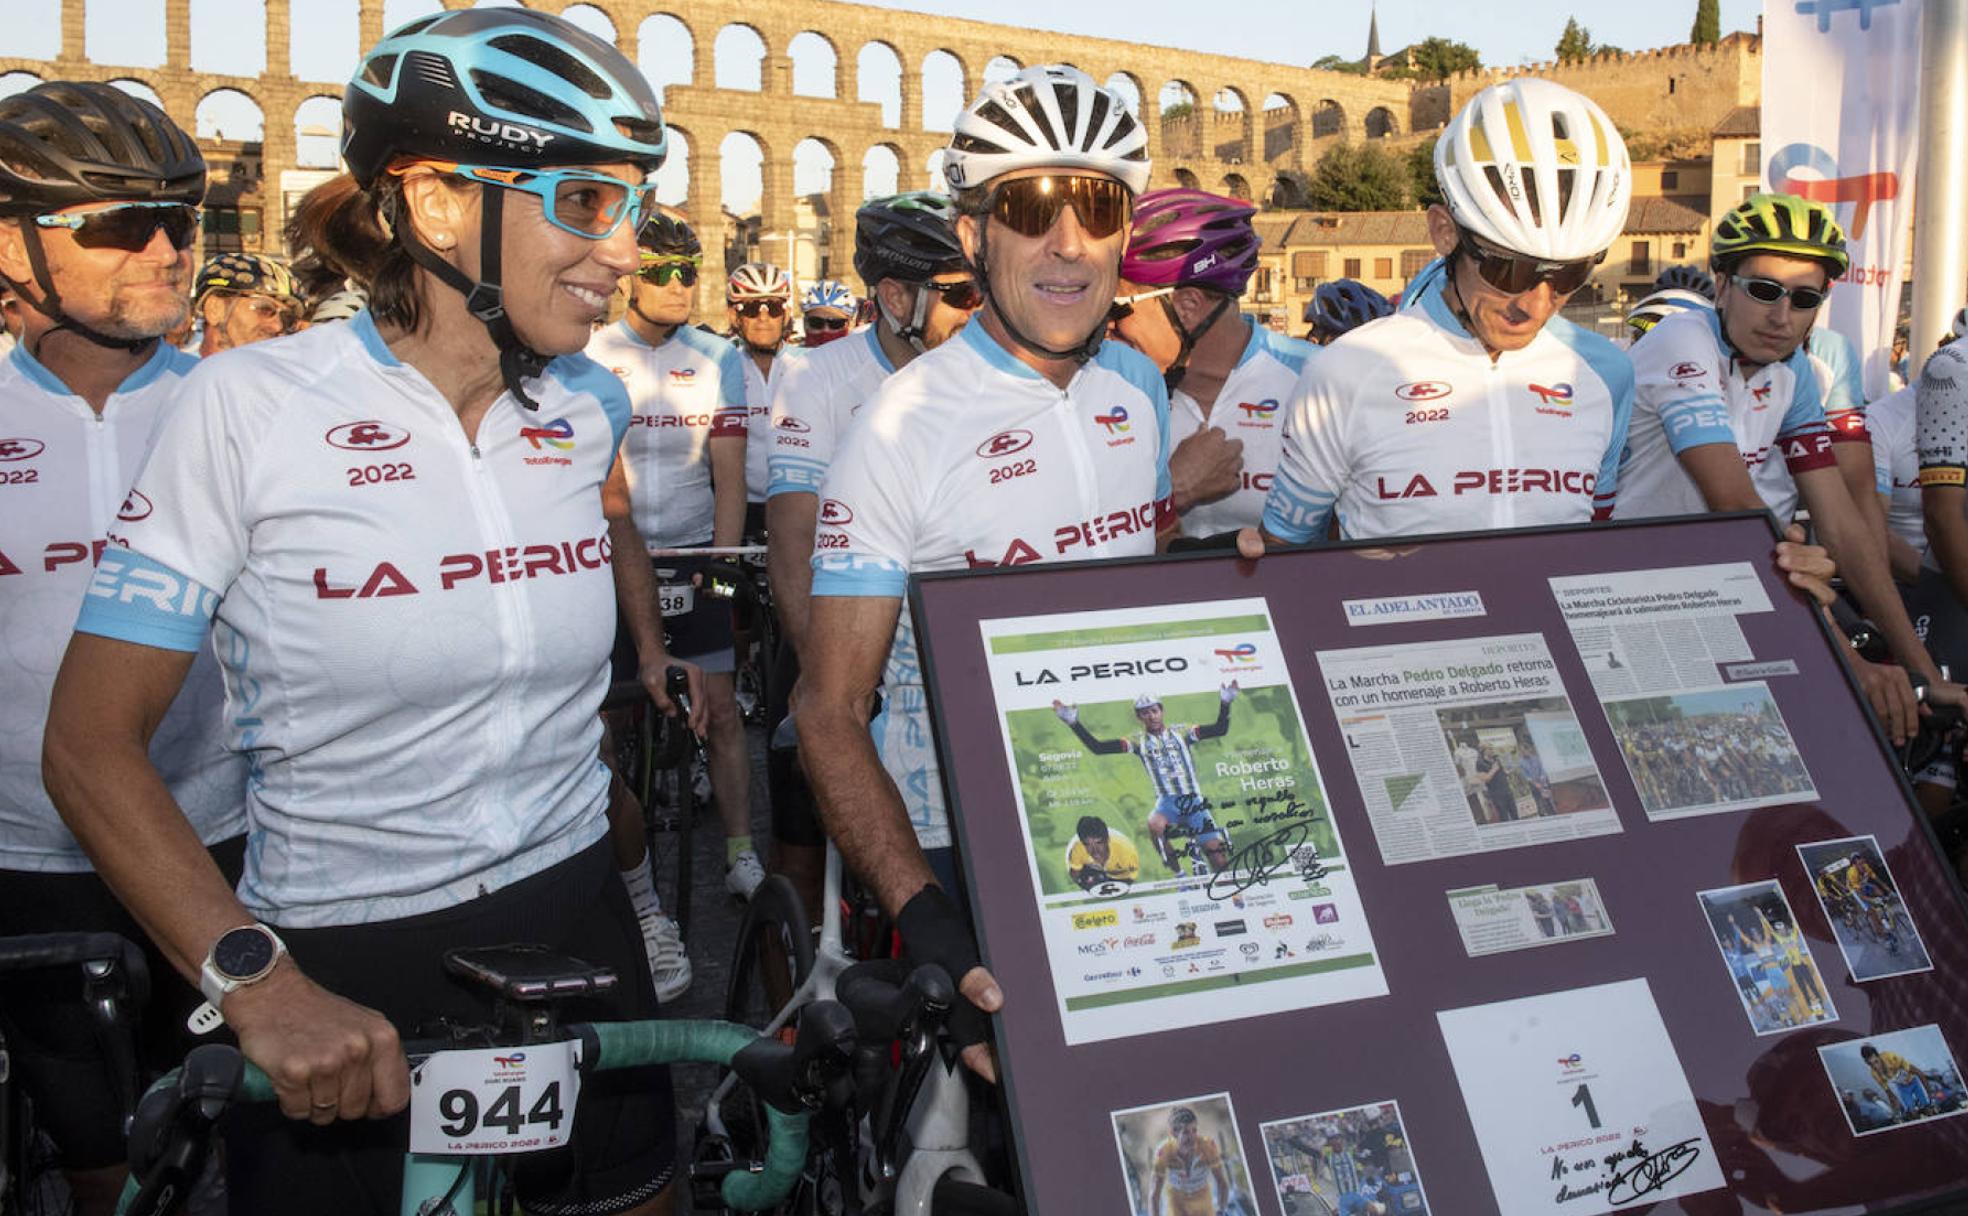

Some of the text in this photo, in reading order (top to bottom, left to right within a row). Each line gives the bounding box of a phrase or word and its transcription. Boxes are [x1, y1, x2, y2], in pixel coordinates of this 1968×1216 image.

[447, 110, 555, 148] RUDY
[454, 128, 544, 155] PROJECT
[629, 413, 711, 428] PERICO
[1405, 408, 1450, 424] 2022
[776, 435, 811, 448] 2022
[346, 462, 416, 488] 2022
[990, 459, 1037, 484] 2022
[1377, 468, 1597, 500] LA PERICO
[817, 533, 850, 549] 2022
[964, 538, 1043, 568] LA
[313, 533, 612, 599] LA PERICO
[1560, 589, 1719, 610] La Marcha Cicloturista Pedro Delgado
[1563, 586, 1612, 597] DEPORTES
[1349, 595, 1479, 616] EL ADELANTADO
[1565, 607, 1623, 620] homenajeará
[1633, 602, 1680, 614] salmantino
[1682, 599, 1716, 609] Roberto
[1717, 597, 1742, 607] Heras
[1015, 656, 1189, 686] LA PERICO
[1329, 658, 1554, 691] La Marcha Pedro Delgado retorna
[1335, 695, 1359, 706] con
[1362, 692, 1379, 703] un
[1382, 685, 1446, 701] homenaje
[1448, 686, 1458, 695] a
[1461, 678, 1511, 694] Roberto
[1514, 675, 1551, 688] Heras
[1039, 751, 1082, 763] Segovia
[1215, 757, 1289, 777] Roberto
[1240, 775, 1296, 792] Heras
[1078, 943, 1106, 955] MGS
[439, 1081, 563, 1138] 944
[1572, 1083, 1602, 1129] 1
[447, 1137, 541, 1150] LA PERICO 2022
[1540, 1145, 1555, 1154] LA
[1557, 1137, 1594, 1151] PERICO
[1551, 1155, 1568, 1181] No
